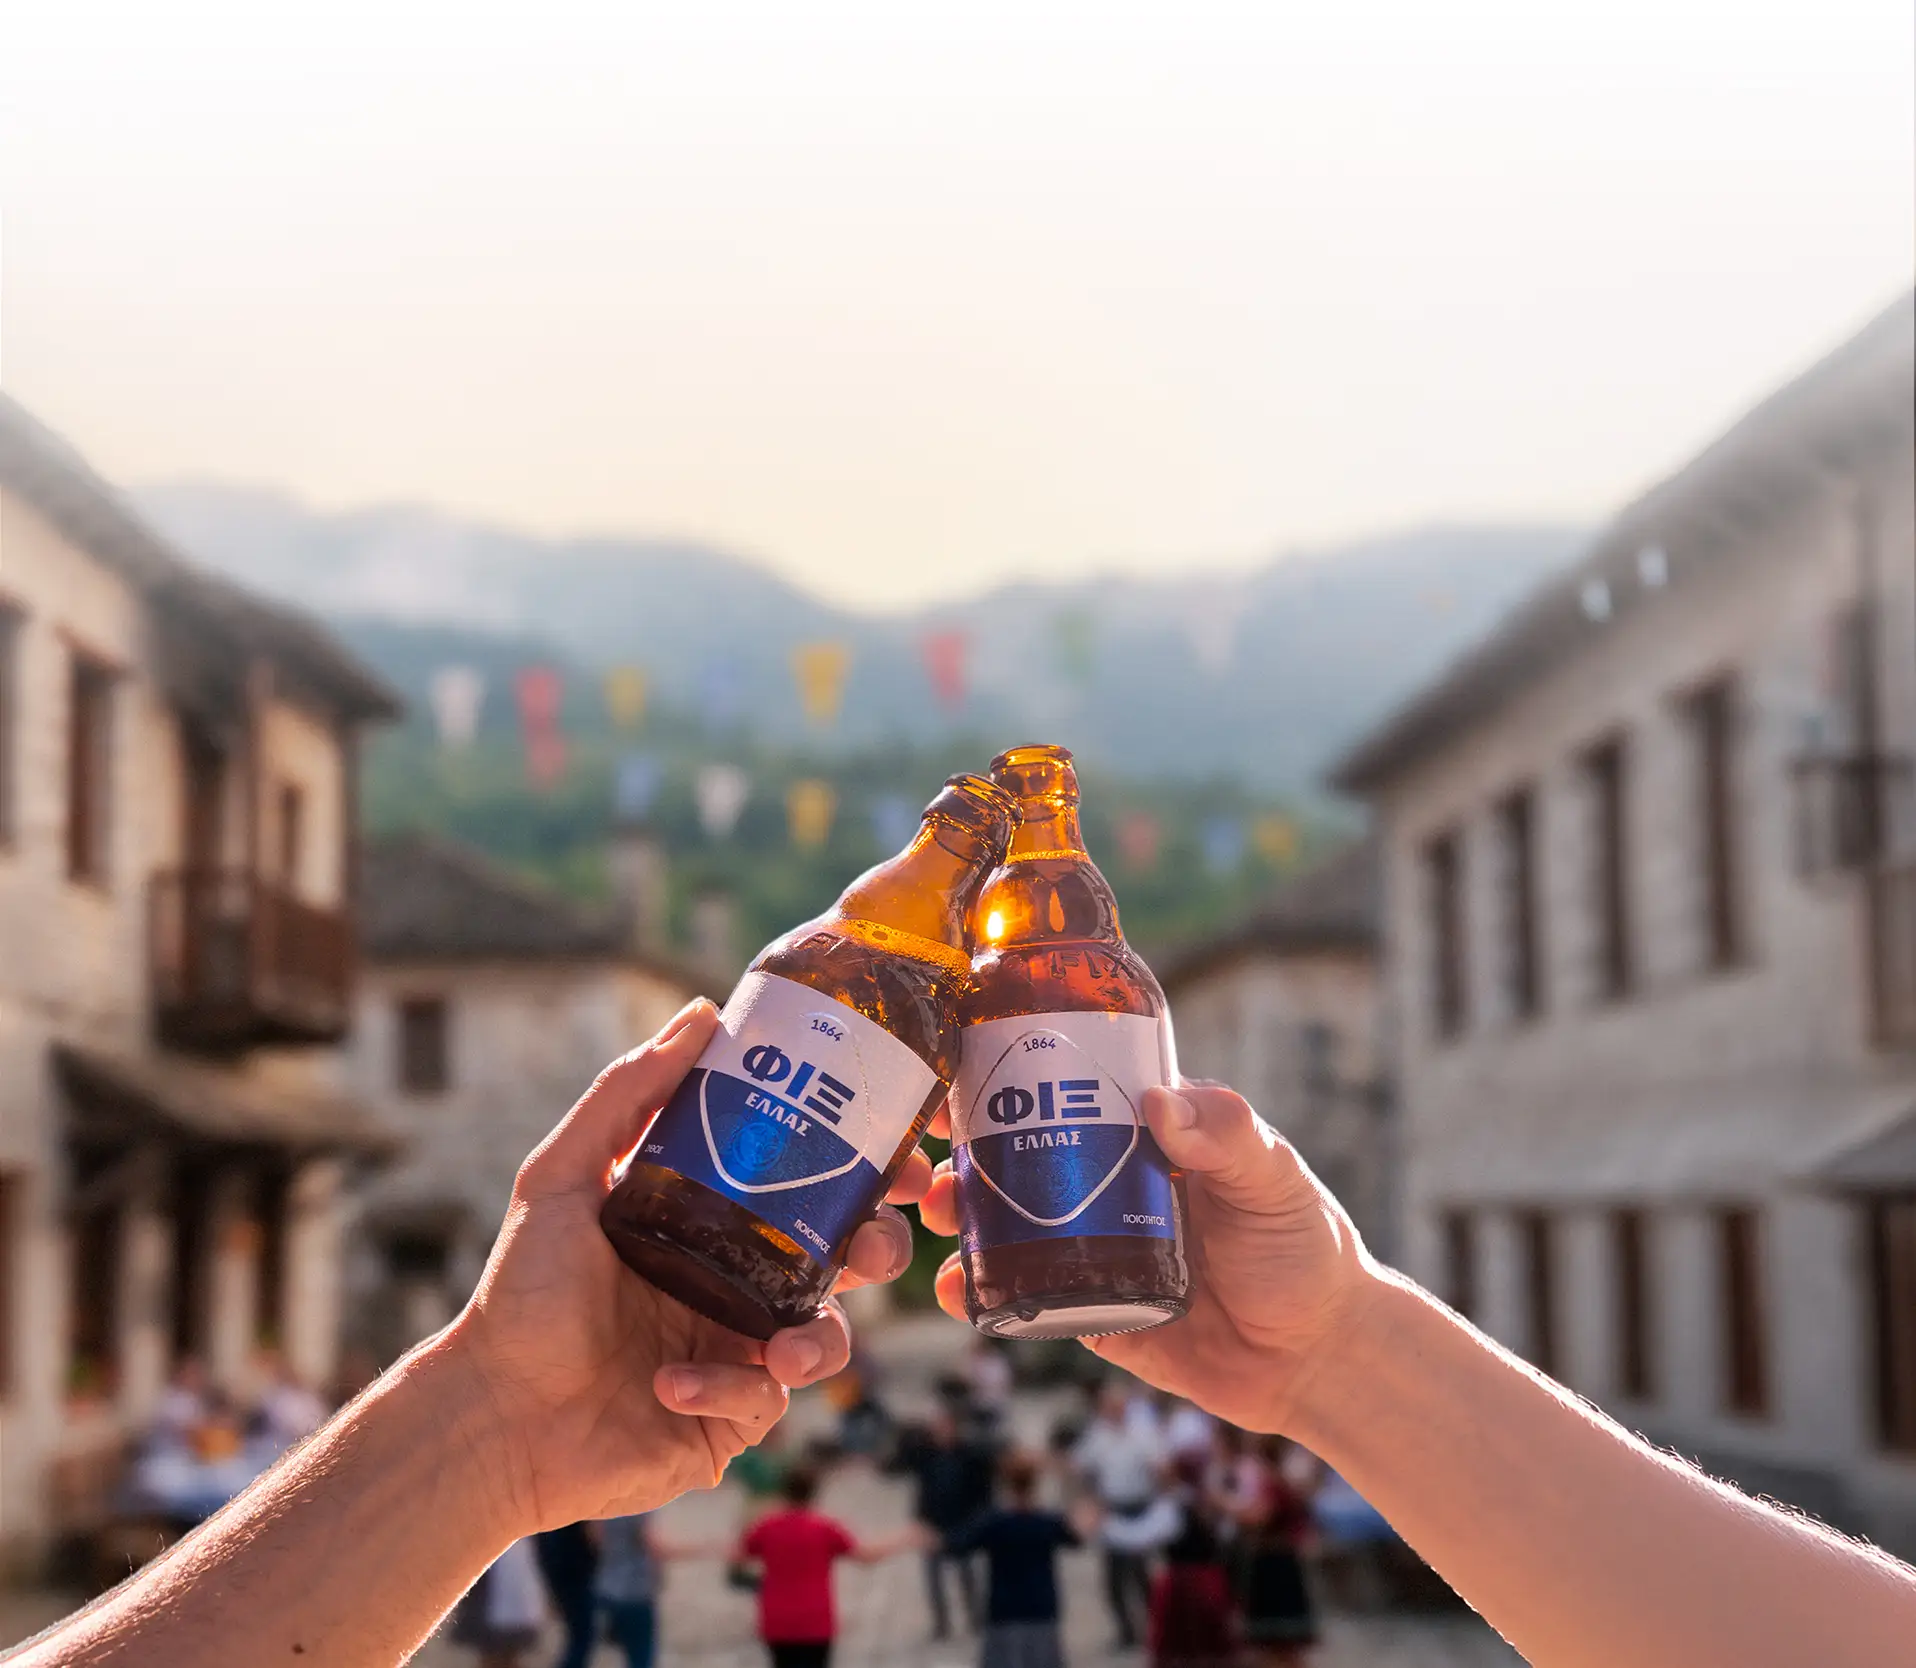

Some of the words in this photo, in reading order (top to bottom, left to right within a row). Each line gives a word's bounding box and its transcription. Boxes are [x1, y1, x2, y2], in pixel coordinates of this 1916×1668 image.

[811, 1019, 844, 1041] 1864
[1023, 1038, 1057, 1052] 1864
[742, 1044, 856, 1126] ΦΙΞ
[744, 1091, 812, 1137] ΕΛΛΑΣ
[987, 1079, 1102, 1126] ΦΙΞ
[1013, 1130, 1082, 1152] ΕΛΛΑΣ
